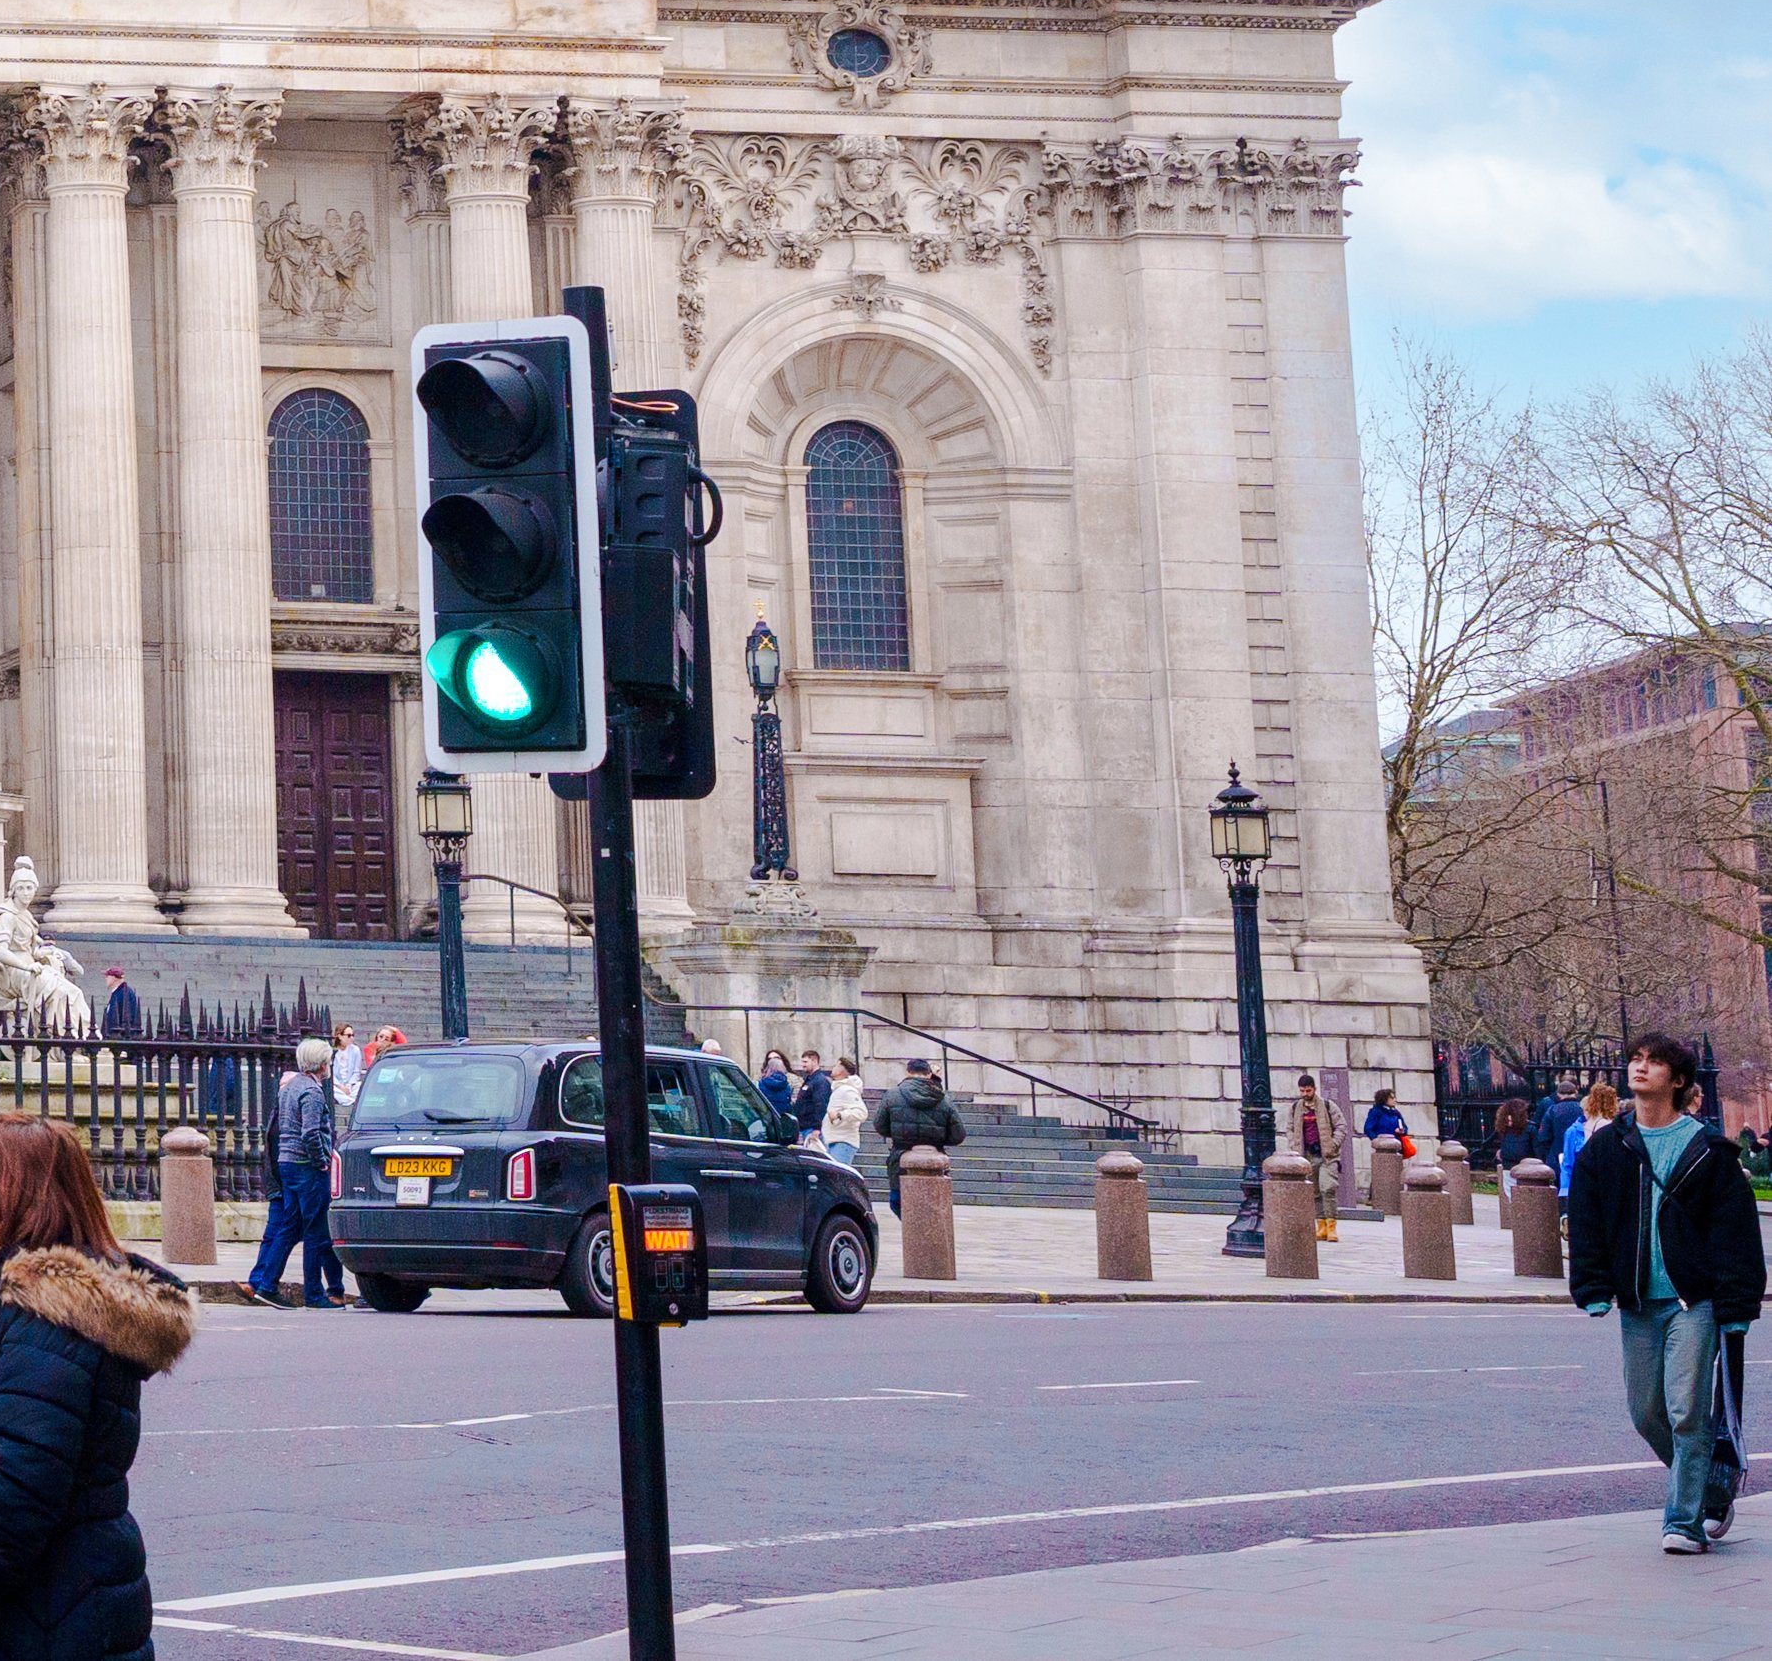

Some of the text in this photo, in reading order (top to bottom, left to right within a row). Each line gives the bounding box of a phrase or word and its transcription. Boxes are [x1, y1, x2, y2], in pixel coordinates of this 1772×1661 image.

[389, 1161, 447, 1174] LD23 KKG
[645, 1231, 690, 1250] WAIT
